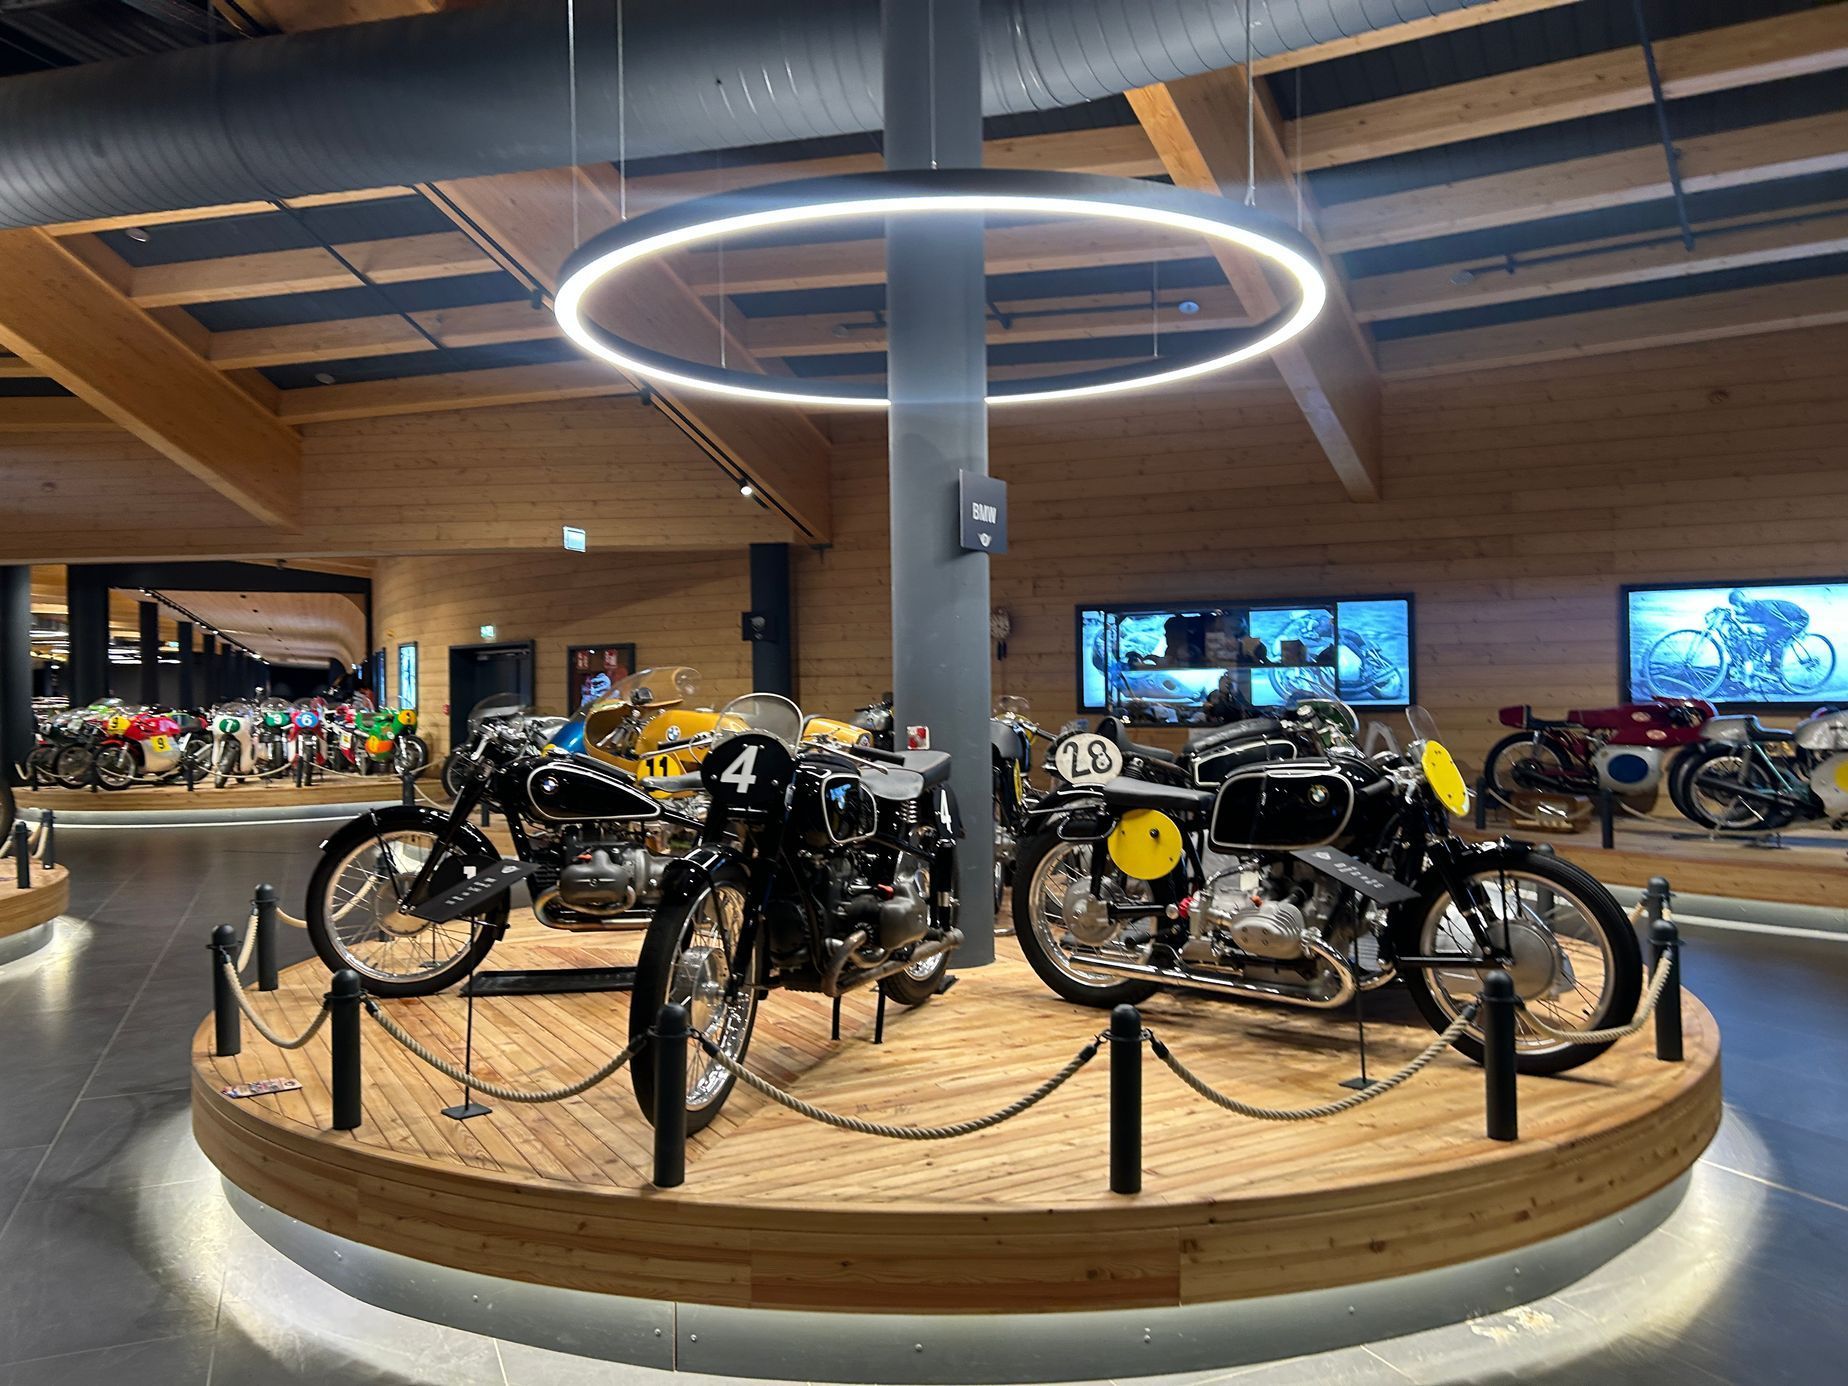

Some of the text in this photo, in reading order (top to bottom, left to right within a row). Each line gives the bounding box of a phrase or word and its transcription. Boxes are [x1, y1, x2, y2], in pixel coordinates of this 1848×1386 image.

[972, 502, 997, 524] BMW
[301, 714, 313, 727] 6
[646, 756, 668, 777] 11
[720, 745, 758, 794] 4
[1063, 740, 1112, 778] 28
[940, 789, 953, 834] 4
